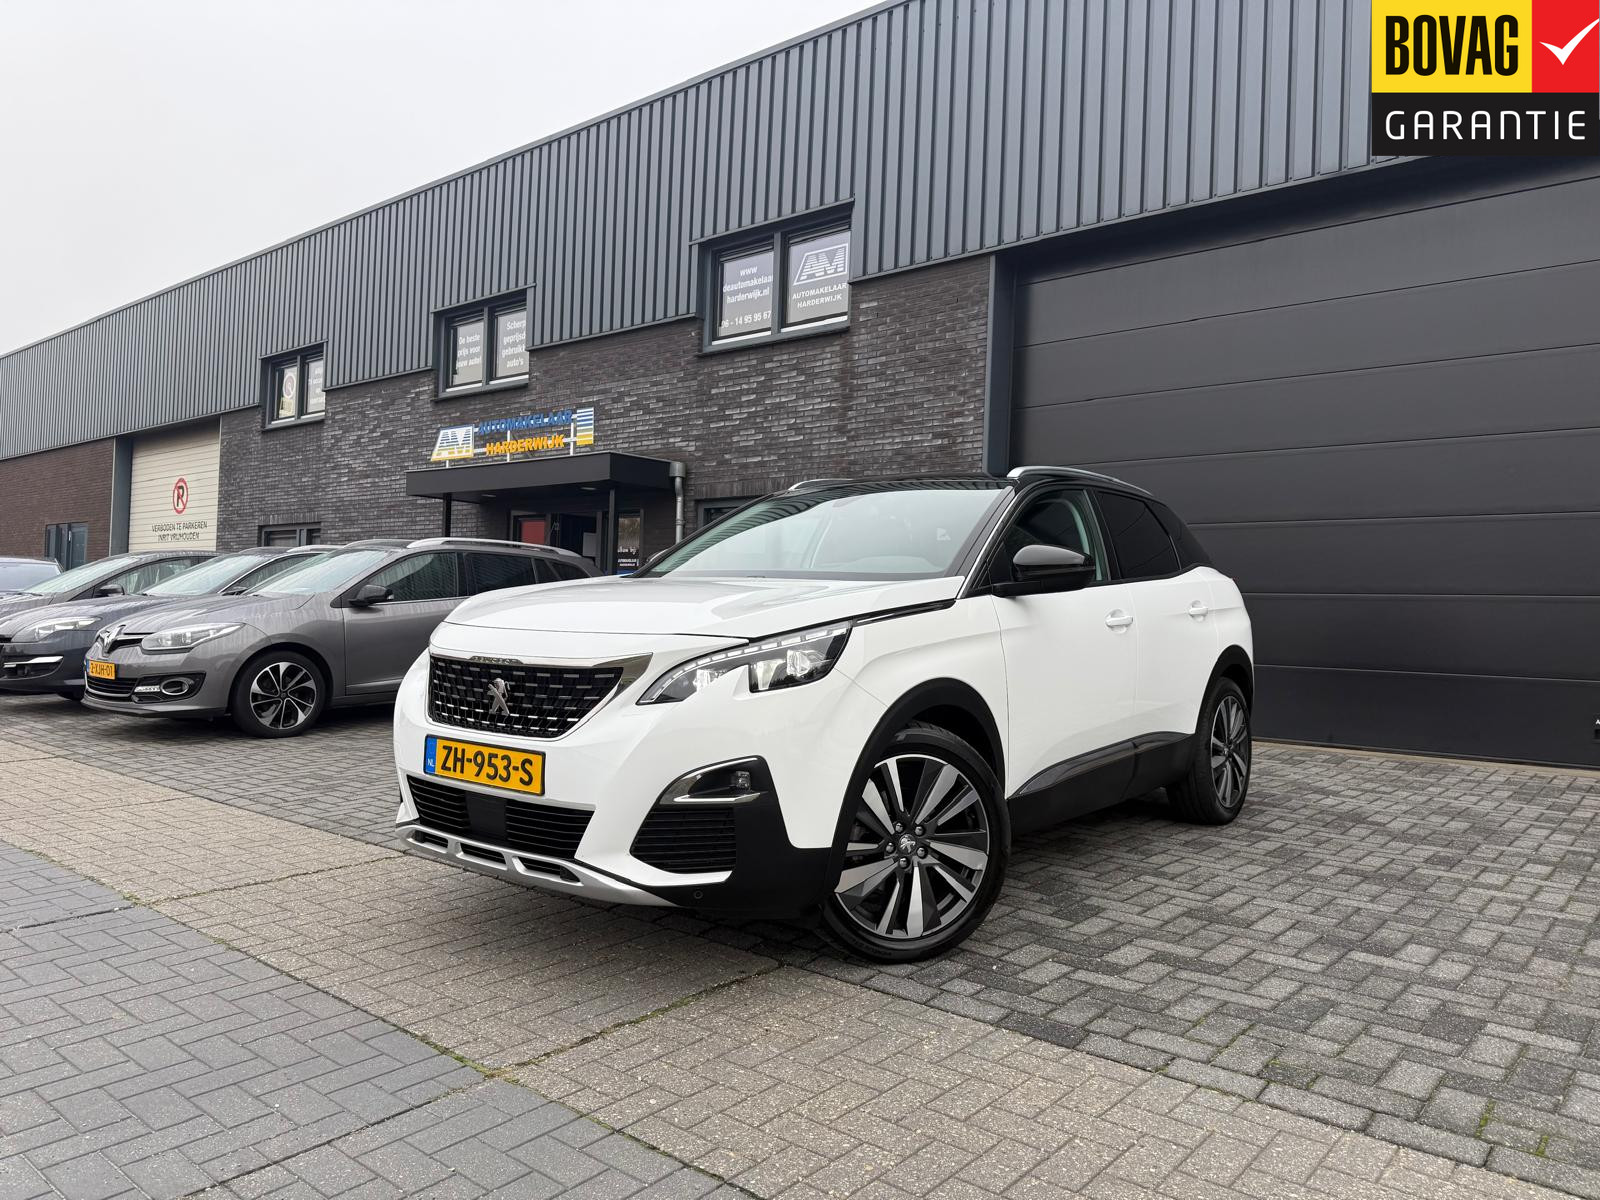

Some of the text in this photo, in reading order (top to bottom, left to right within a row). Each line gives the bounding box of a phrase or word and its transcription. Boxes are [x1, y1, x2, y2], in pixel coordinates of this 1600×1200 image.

[739, 266, 758, 276] www
[726, 287, 770, 304] harderwijk.nl
[792, 282, 847, 300] AUTOMAKELAAR
[797, 293, 842, 309] HARDERWIJK
[503, 330, 526, 346] geprijsd
[502, 343, 526, 358] gebruikt
[477, 410, 573, 435] AUTOMAKELAAR
[485, 434, 565, 456] HARDERWIJK
[152, 520, 208, 532] VERBODEN TE PARKEREN
[427, 759, 435, 768] NL
[441, 745, 533, 786] ZH-953-S
